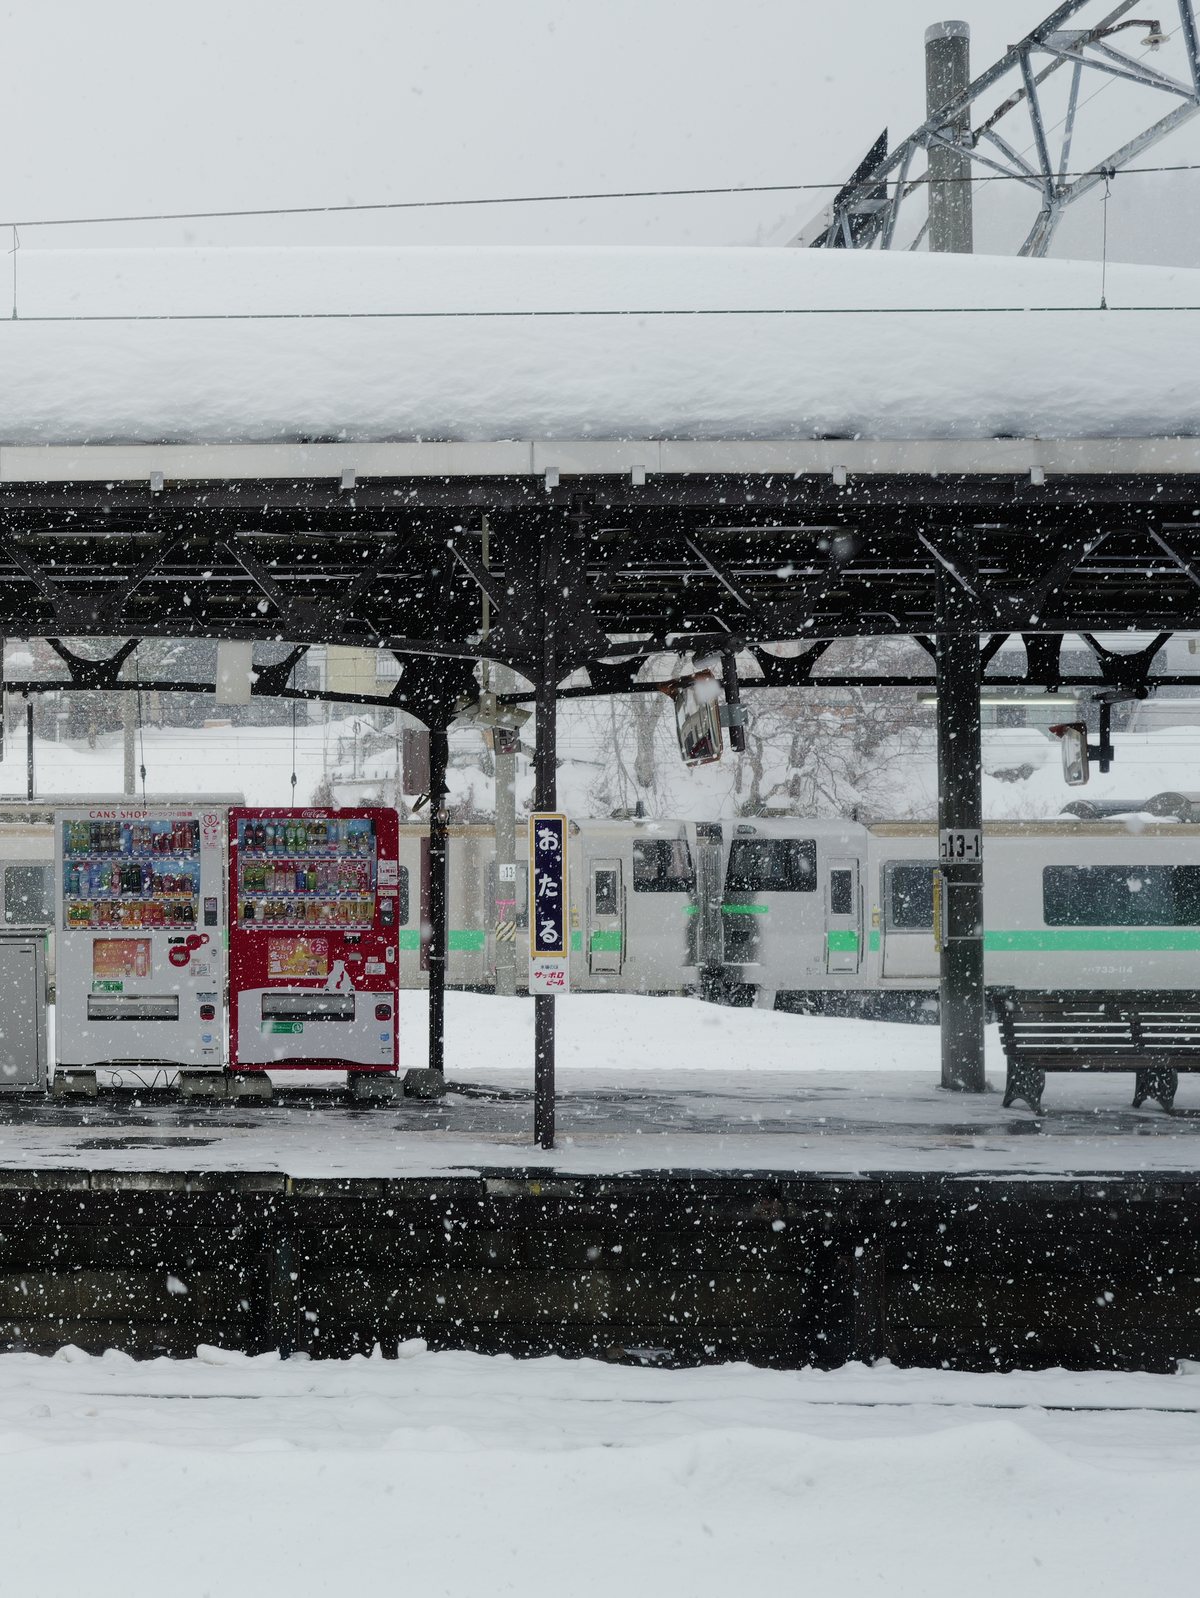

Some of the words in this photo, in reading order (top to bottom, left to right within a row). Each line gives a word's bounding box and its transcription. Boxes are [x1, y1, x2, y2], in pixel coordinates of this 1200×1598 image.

[89, 810, 117, 819] CANS
[120, 810, 148, 819] SHOP
[538, 827, 559, 944] おたる
[534, 971, 565, 979] サッポロ
